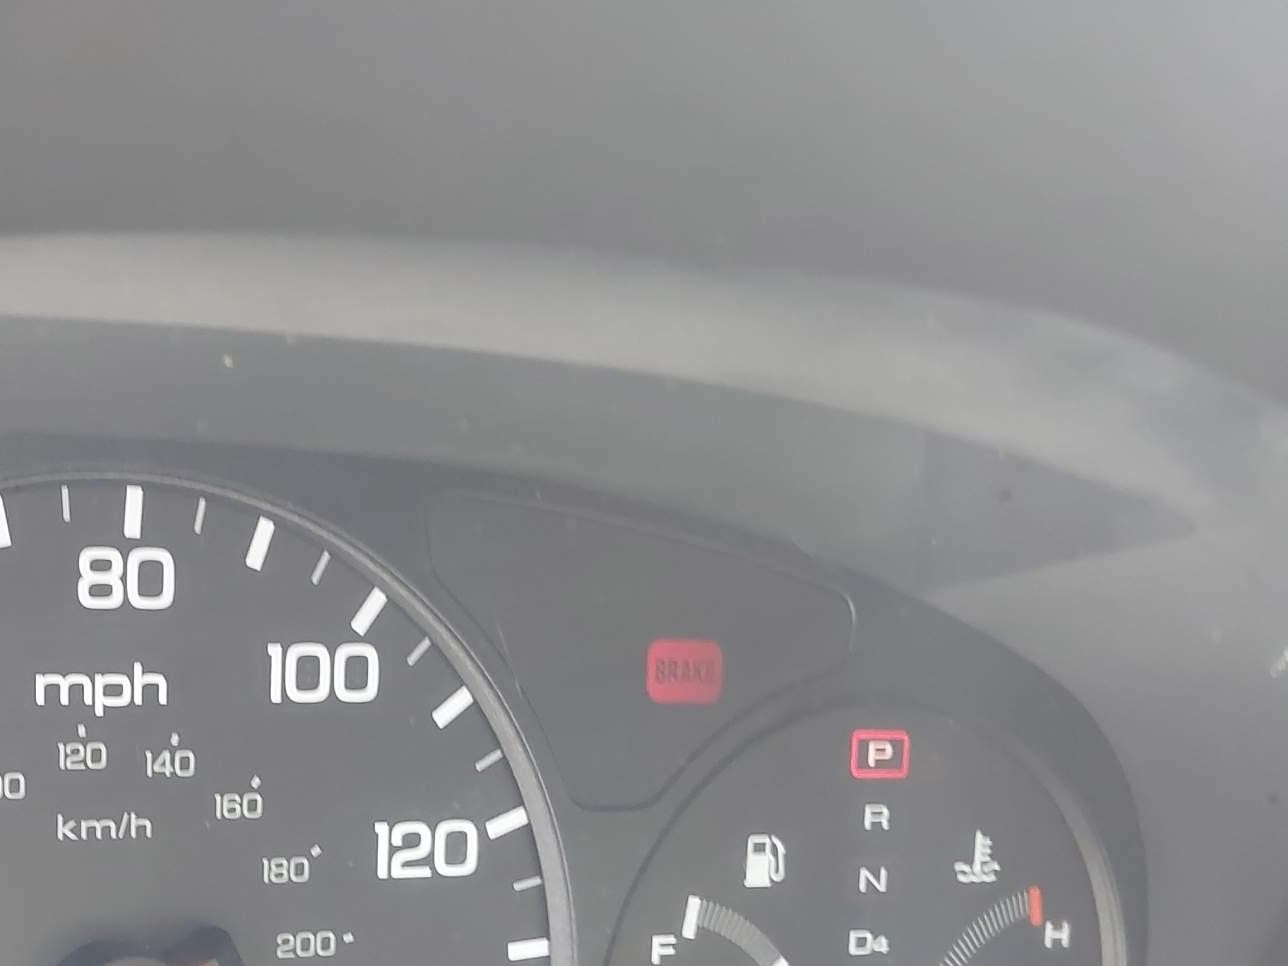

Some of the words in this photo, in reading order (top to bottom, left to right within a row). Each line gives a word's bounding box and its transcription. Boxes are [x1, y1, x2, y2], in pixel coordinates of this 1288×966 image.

[77, 546, 175, 610] 80
[267, 642, 380, 704] 100
[35, 661, 168, 717] mph
[57, 742, 107, 770] 120
[145, 750, 195, 778] 140
[867, 741, 893, 768] P
[214, 793, 263, 820] 160
[864, 804, 890, 830] R
[57, 812, 152, 841] km/h
[374, 819, 479, 879] 120
[262, 857, 310, 884] 180
[858, 866, 888, 893] N
[276, 931, 336, 959] 200
[1044, 921, 1070, 949] H
[651, 934, 677, 965] F
